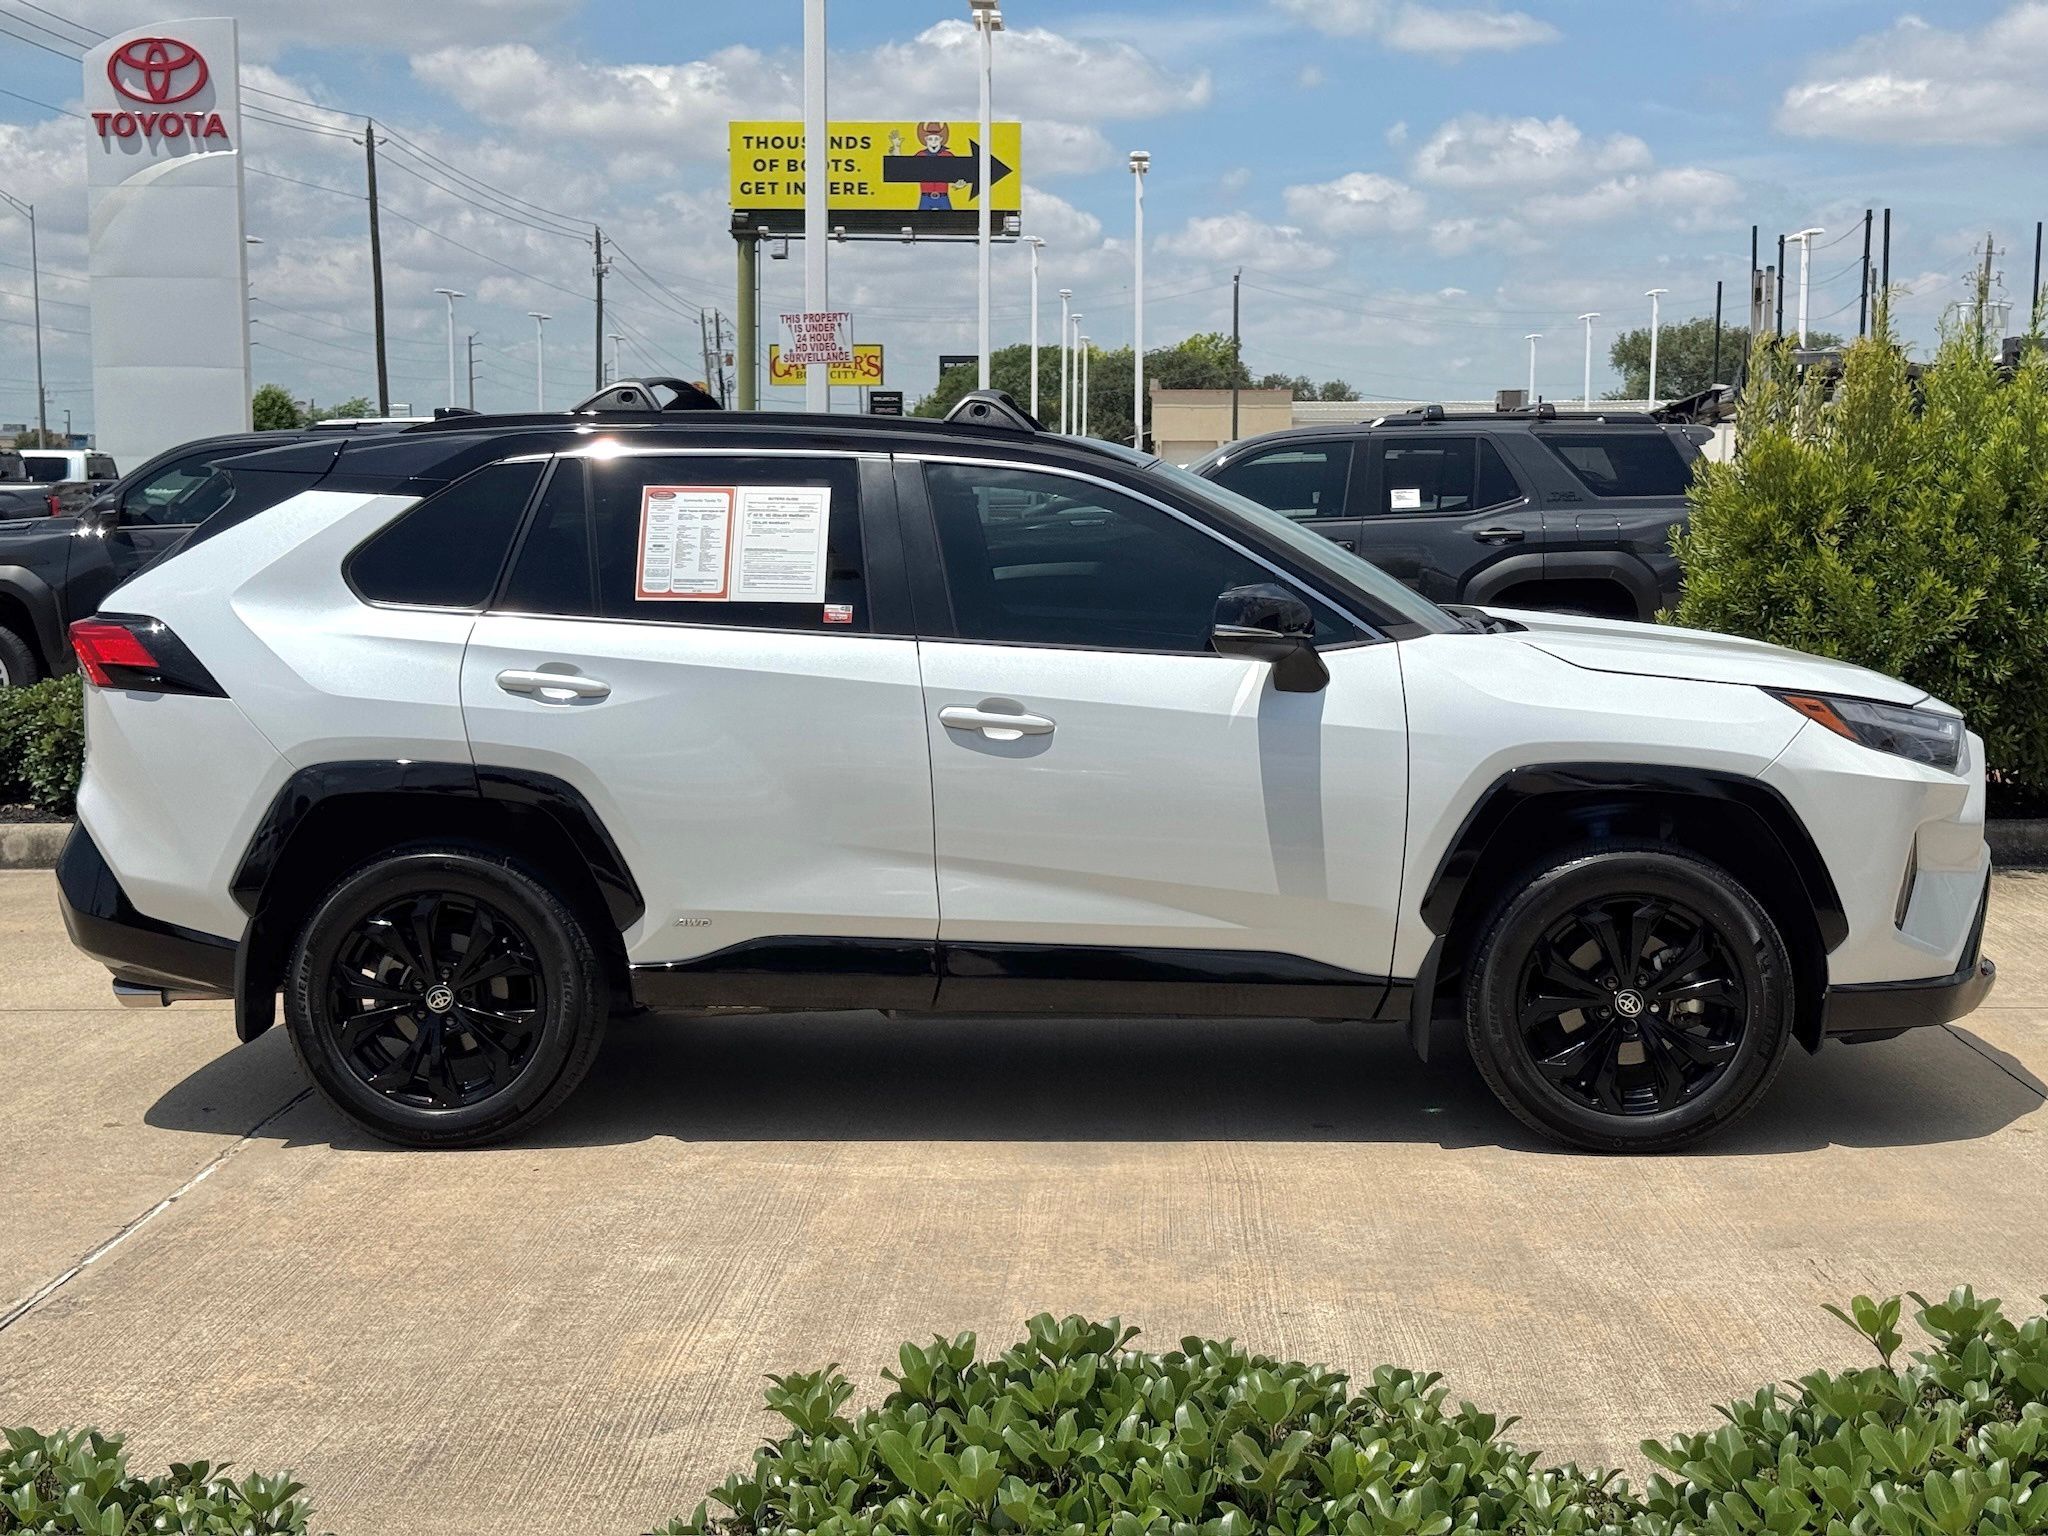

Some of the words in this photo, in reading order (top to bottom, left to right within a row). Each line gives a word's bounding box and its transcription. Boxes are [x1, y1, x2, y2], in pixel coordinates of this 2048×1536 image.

[91, 112, 229, 138] TOYOTA
[742, 136, 872, 150] THOUNDS
[753, 159, 780, 172] OF
[787, 159, 862, 172] BTS.
[740, 182, 779, 195] GET
[786, 182, 806, 195] IN
[829, 182, 875, 195] ERE.
[780, 314, 801, 324] THIS
[803, 312, 850, 323] PROPERTY
[794, 324, 803, 333] IS
[805, 323, 836, 333] UNDER
[796, 333, 807, 343] 24
[809, 332, 835, 342] HOUR
[795, 343, 808, 353] HD
[810, 342, 837, 352] VIDEO
[783, 351, 850, 363] SURVEILLANCE
[830, 370, 857, 379] CITY
